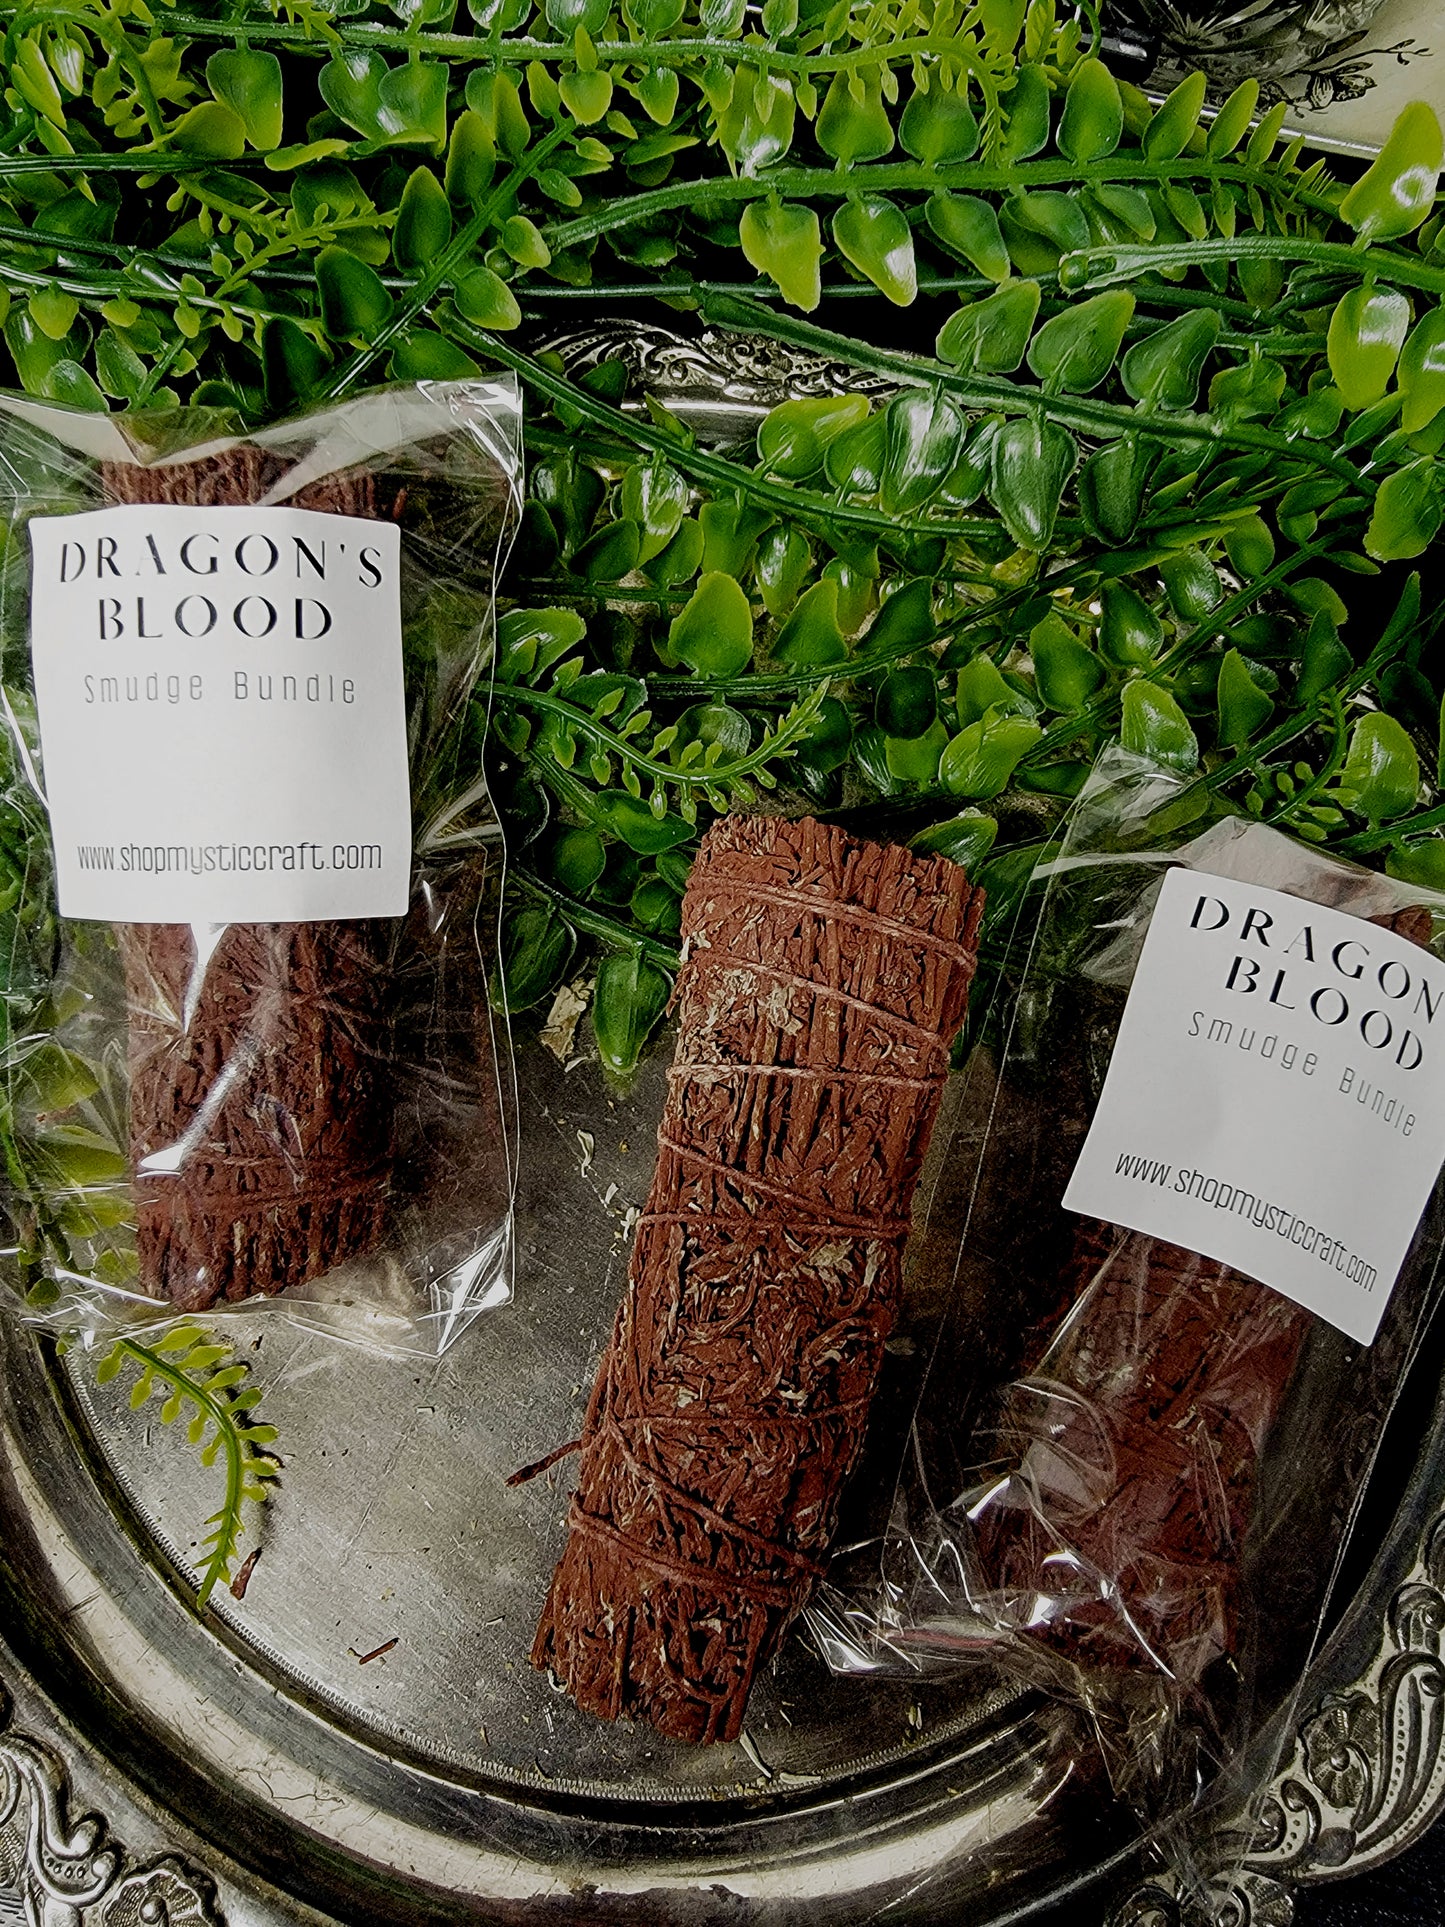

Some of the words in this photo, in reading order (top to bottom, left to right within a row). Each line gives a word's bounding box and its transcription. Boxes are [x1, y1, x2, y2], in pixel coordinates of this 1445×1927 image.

[60, 533, 382, 588] DRAGON'S
[99, 595, 332, 640] BLOOD
[84, 672, 203, 704] Smudge
[234, 671, 355, 704] Bundle
[77, 843, 382, 874] www.shopmysticcraft.com
[1225, 956, 1423, 1070] BLOOD
[1188, 1011, 1318, 1076] Smudge
[1338, 1067, 1416, 1137] Bundle
[1115, 1153, 1377, 1292] www.shopmysticcraft.com
